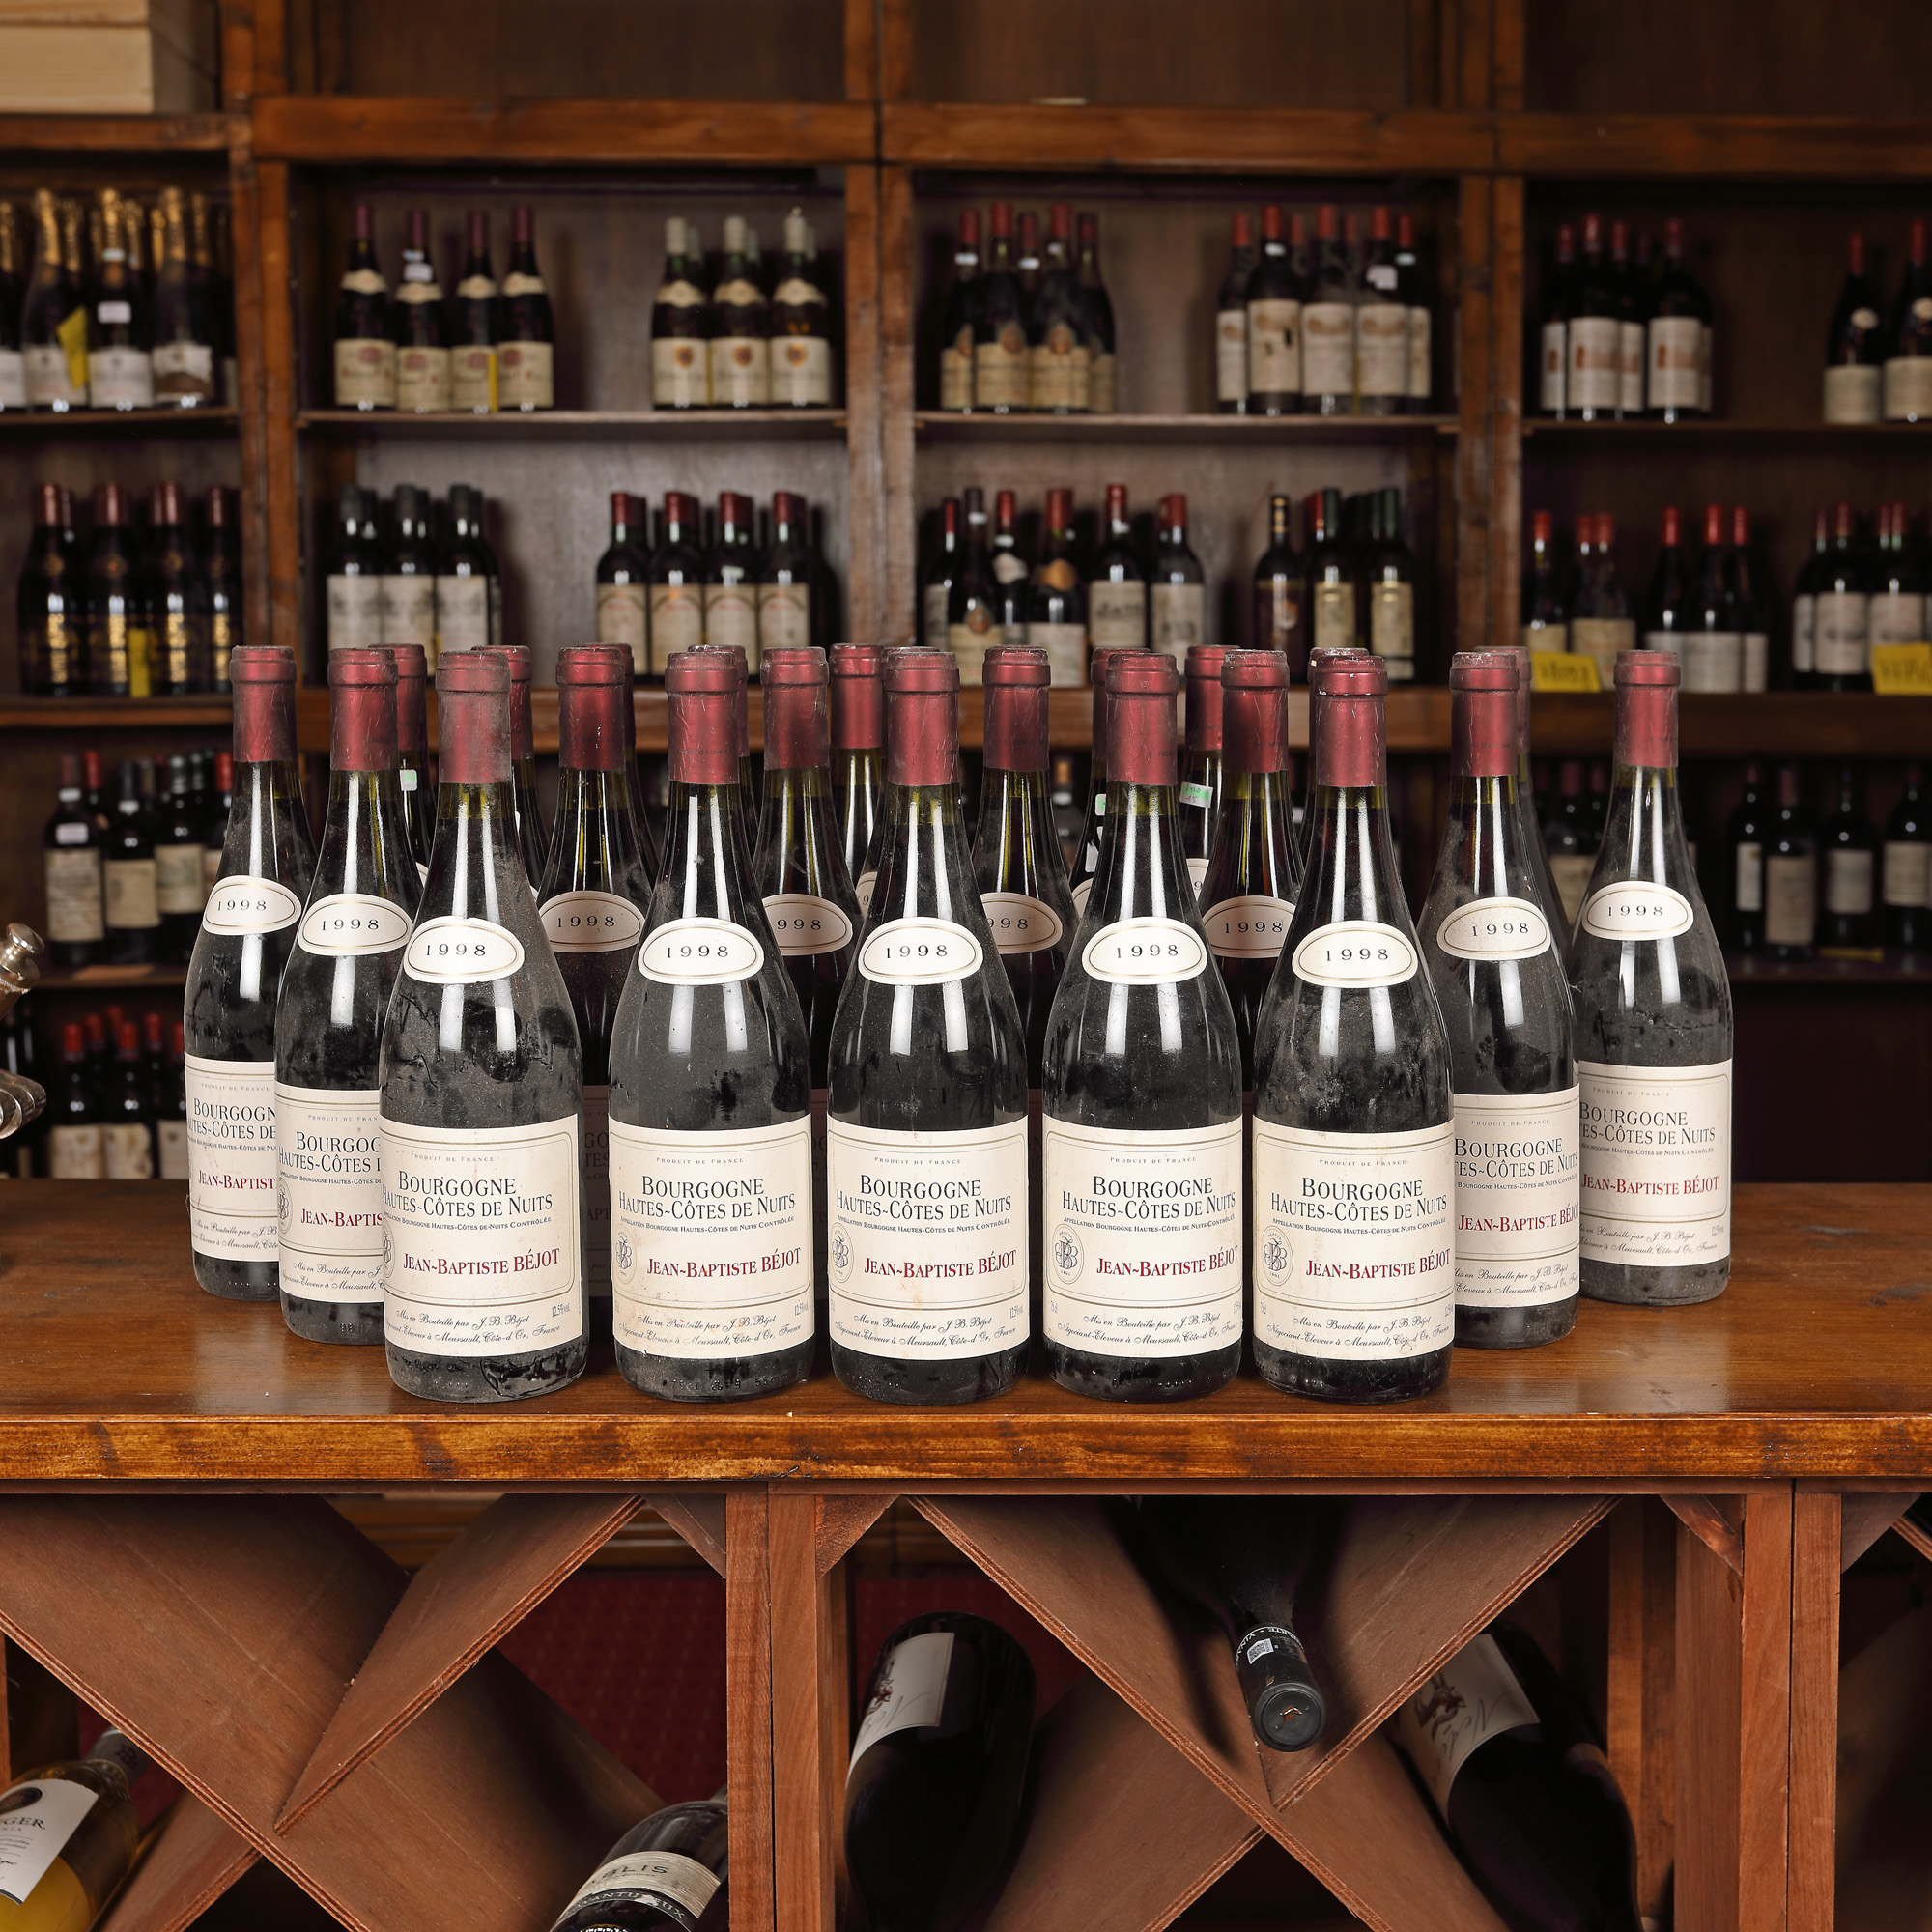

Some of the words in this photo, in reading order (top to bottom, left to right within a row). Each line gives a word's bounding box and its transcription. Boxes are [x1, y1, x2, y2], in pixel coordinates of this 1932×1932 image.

[217, 900, 268, 912] 1998
[1606, 905, 1663, 918] 1998
[321, 919, 379, 932] 1998
[557, 916, 615, 928] 1998
[777, 918, 822, 931] 998
[1223, 922, 1285, 936] 1998
[1471, 922, 1529, 937] 1998
[425, 944, 487, 957] 1998
[667, 945, 729, 959] 1998
[886, 945, 949, 959] 1998
[1115, 943, 1179, 959] 1998
[1324, 948, 1389, 962] 1998
[193, 1097, 275, 1122] BOURGOGN
[260, 1125, 276, 1139] DE
[1658, 1131, 1676, 1145] DE
[1681, 1127, 1716, 1145] NUITS
[296, 1131, 381, 1153] BOURGOG
[1454, 1138, 1563, 1157] BOURGOGNE
[411, 1152, 441, 1162] PRODUIT
[874, 1156, 909, 1165] PRODUIT
[1539, 1159, 1555, 1176] DE
[399, 1170, 517, 1197] BOURGOGNE
[641, 1175, 764, 1200] BOURGOGNE
[860, 1174, 981, 1200] BOURGOGNE
[1093, 1175, 1213, 1199] BOURGOGNE
[1302, 1177, 1423, 1201] BOURGOGNE
[1683, 1175, 1719, 1195] BÉJOT
[481, 1201, 503, 1217] DE
[508, 1193, 553, 1215] NUITS
[731, 1201, 753, 1218] DE
[757, 1193, 796, 1216] NUITS
[949, 1203, 970, 1219] DE
[975, 1195, 1011, 1217] NUITS
[1184, 1201, 1203, 1217] DE
[1207, 1191, 1236, 1214] NUITS
[1394, 1203, 1412, 1220] DE
[1416, 1194, 1447, 1217] NUITS
[401, 1217, 430, 1229] BOURGOGNE
[645, 1222, 679, 1232] BOURGOGNE
[739, 1222, 757, 1231] NUITS
[864, 1221, 896, 1232] BOURGOGNE
[1095, 1223, 1132, 1232] BOURGOGNE
[1190, 1221, 1207, 1230] NUITS
[1305, 1224, 1342, 1234] BOURGOGNE
[513, 1248, 560, 1273] BÉJOT
[761, 1247, 801, 1273] BÉJOT
[978, 1249, 1017, 1275] BÉJOT
[1209, 1245, 1239, 1271] BÉJOT
[1419, 1248, 1450, 1274] BÉJOT
[395, 1309, 409, 1319] Mis
[419, 1313, 453, 1327] Bouteille
[453, 1321, 470, 1329] par
[853, 1314, 870, 1324] Mis
[882, 1317, 921, 1330] Bouteille
[920, 1323, 937, 1332] par
[1083, 1314, 1102, 1325] Mis
[1117, 1317, 1155, 1329] Bouteille
[1155, 1321, 1172, 1331] par
[1293, 1316, 1311, 1327] Mis
[1325, 1318, 1366, 1331] Bouteille
[1365, 1323, 1381, 1333] par
